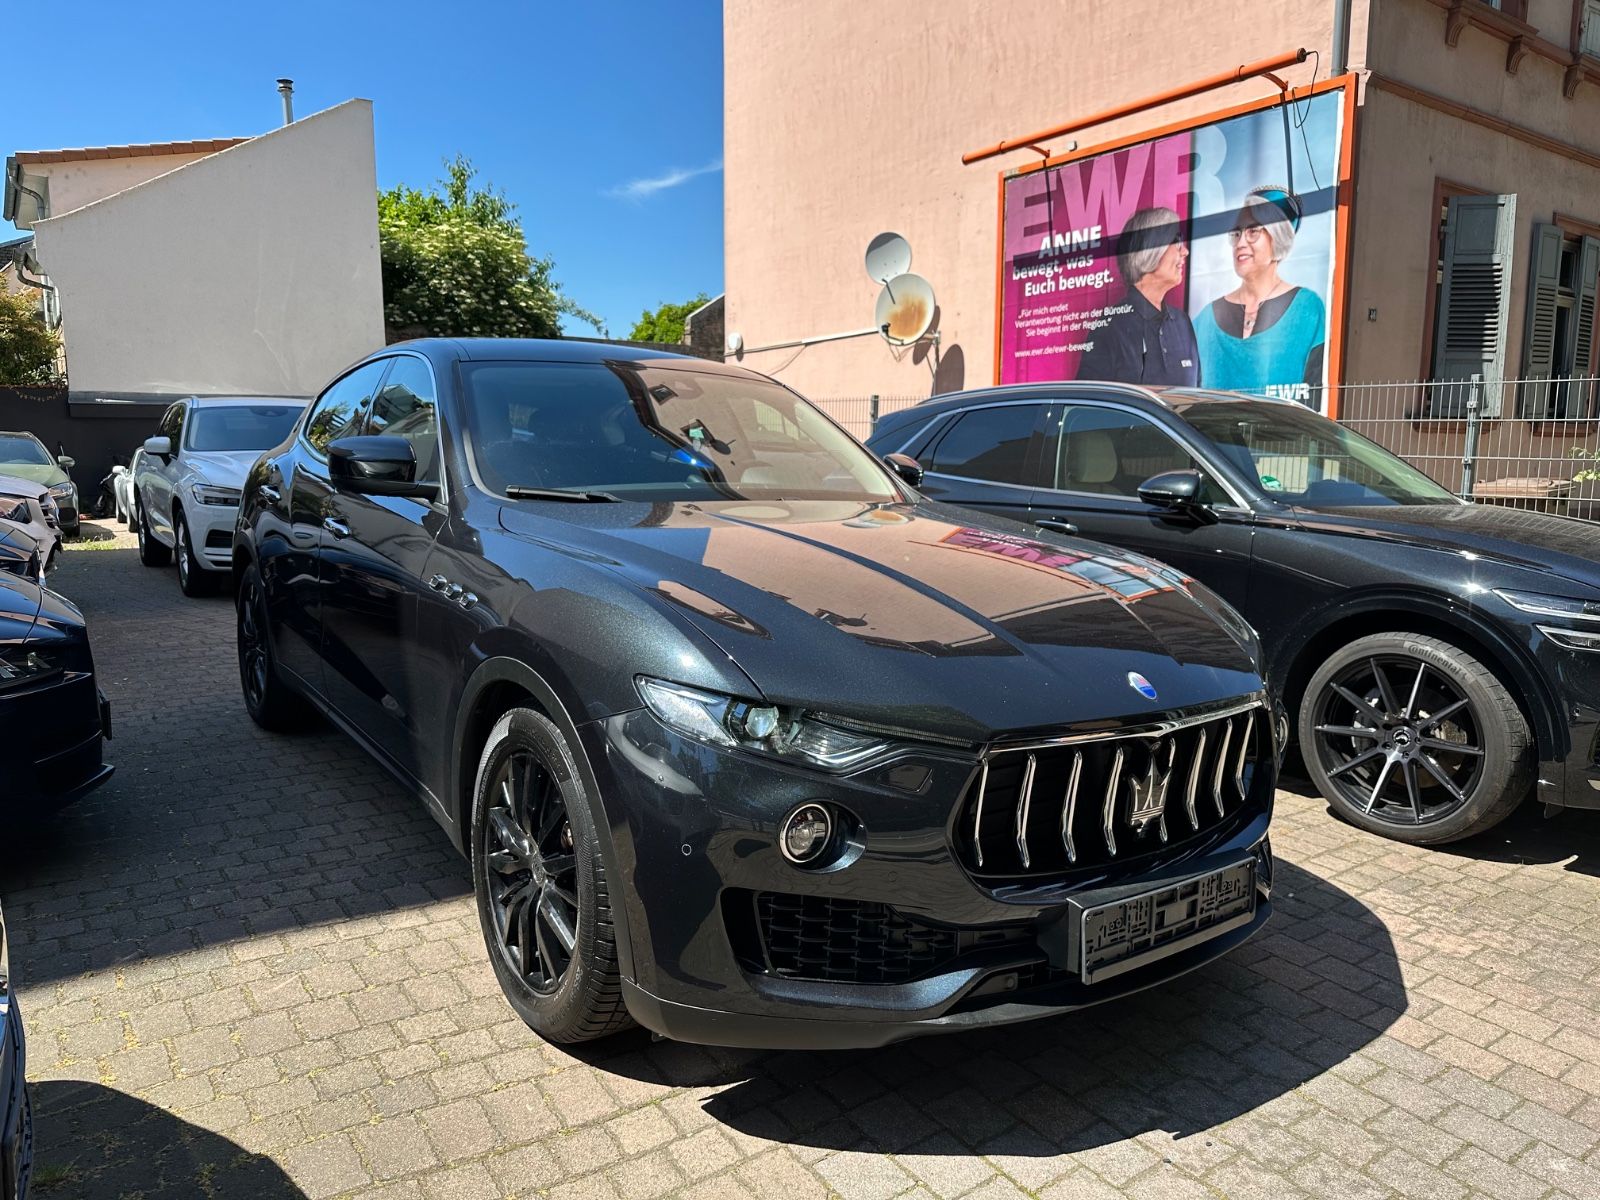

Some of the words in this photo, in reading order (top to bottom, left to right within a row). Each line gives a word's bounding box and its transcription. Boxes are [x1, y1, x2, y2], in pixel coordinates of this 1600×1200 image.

[1005, 126, 1227, 262] EWR
[1038, 225, 1102, 259] ANNE
[1012, 260, 1062, 280] bewegt,
[1067, 253, 1094, 270] was
[1025, 277, 1055, 297] Euch
[1059, 269, 1113, 290] bewegt.
[1015, 314, 1062, 328] Verantwortung
[1062, 311, 1079, 322] nicht
[1080, 311, 1089, 319] an
[1090, 308, 1102, 318] der
[1104, 304, 1134, 316] Bürotür.
[1033, 306, 1048, 315] mich
[1049, 303, 1068, 312] endet
[1026, 328, 1036, 337] Sie
[1037, 324, 1061, 336] beginnt
[1062, 323, 1069, 332] in
[1070, 321, 1082, 331] der
[1014, 341, 1094, 358] www.ewr.de/ewr-bewegt
[1265, 382, 1310, 400] EWR
[1408, 644, 1462, 677] Continental
